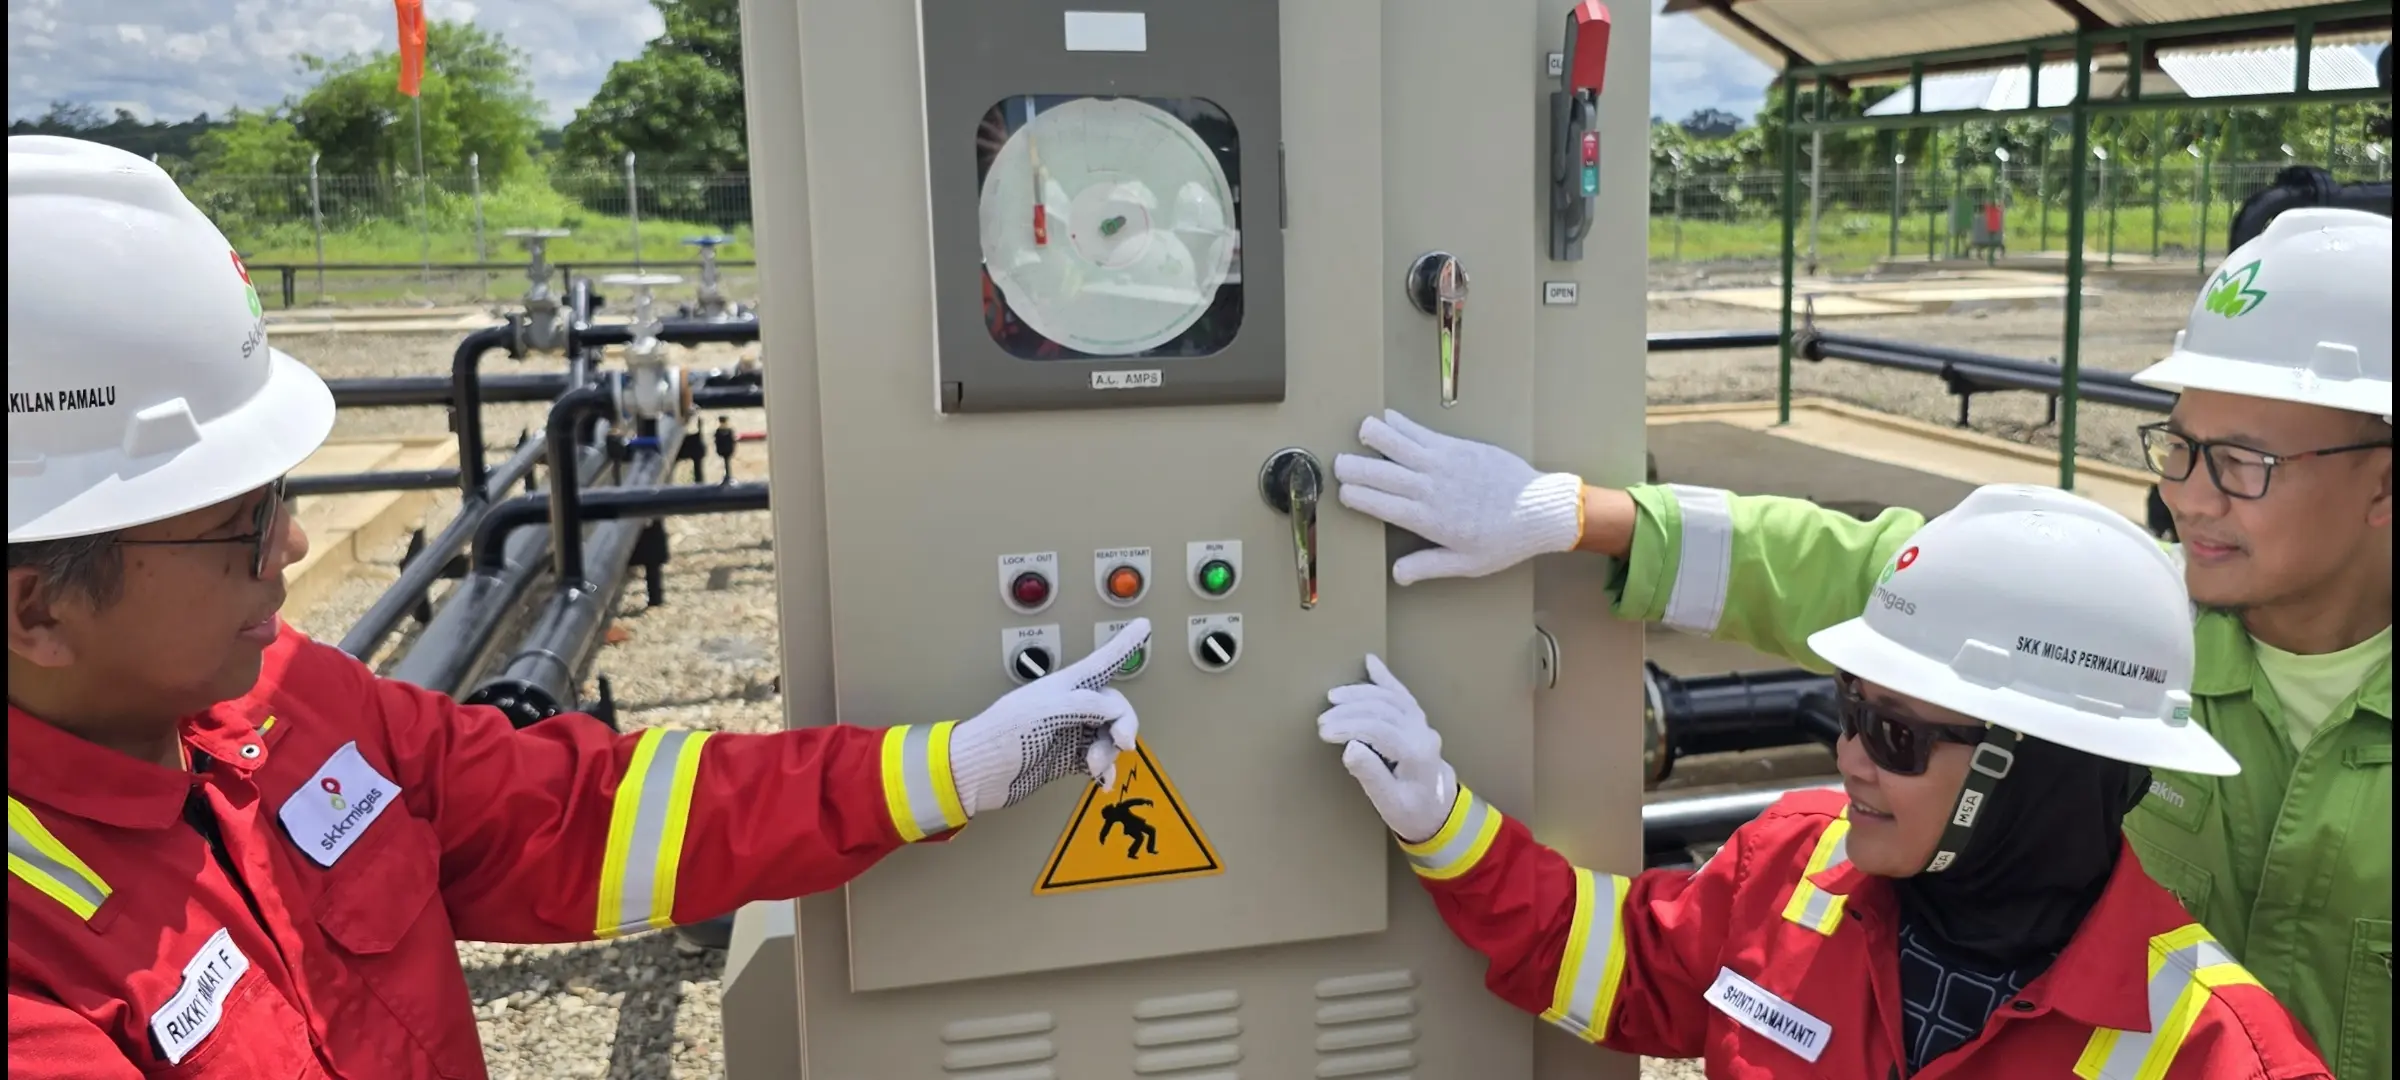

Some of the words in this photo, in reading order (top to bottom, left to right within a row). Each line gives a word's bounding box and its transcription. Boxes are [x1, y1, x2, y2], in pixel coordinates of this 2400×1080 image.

[1550, 287, 1574, 298] OPEN
[1125, 373, 1158, 384] AMPS
[8, 392, 55, 413] KILAN
[59, 386, 115, 411] PAMALU
[1003, 557, 1026, 565] LOCK
[1036, 553, 1052, 562] OUT
[1096, 551, 1117, 559] READY
[1120, 550, 1128, 558] TO
[1130, 549, 1149, 557] START
[1191, 617, 1207, 625] OFF
[2016, 636, 2041, 655] SKK
[2041, 642, 2077, 665] MIGAS
[2078, 651, 2140, 679] PERWAKILAN
[2139, 666, 2168, 684] PAMALU
[320, 788, 383, 851] skkmigas
[1958, 795, 1978, 824] MSA
[166, 994, 209, 1044] RIKKY
[218, 948, 232, 970] F
[1723, 985, 1756, 1015] SHINTA
[1754, 1003, 1817, 1049] DAMAYANTI
